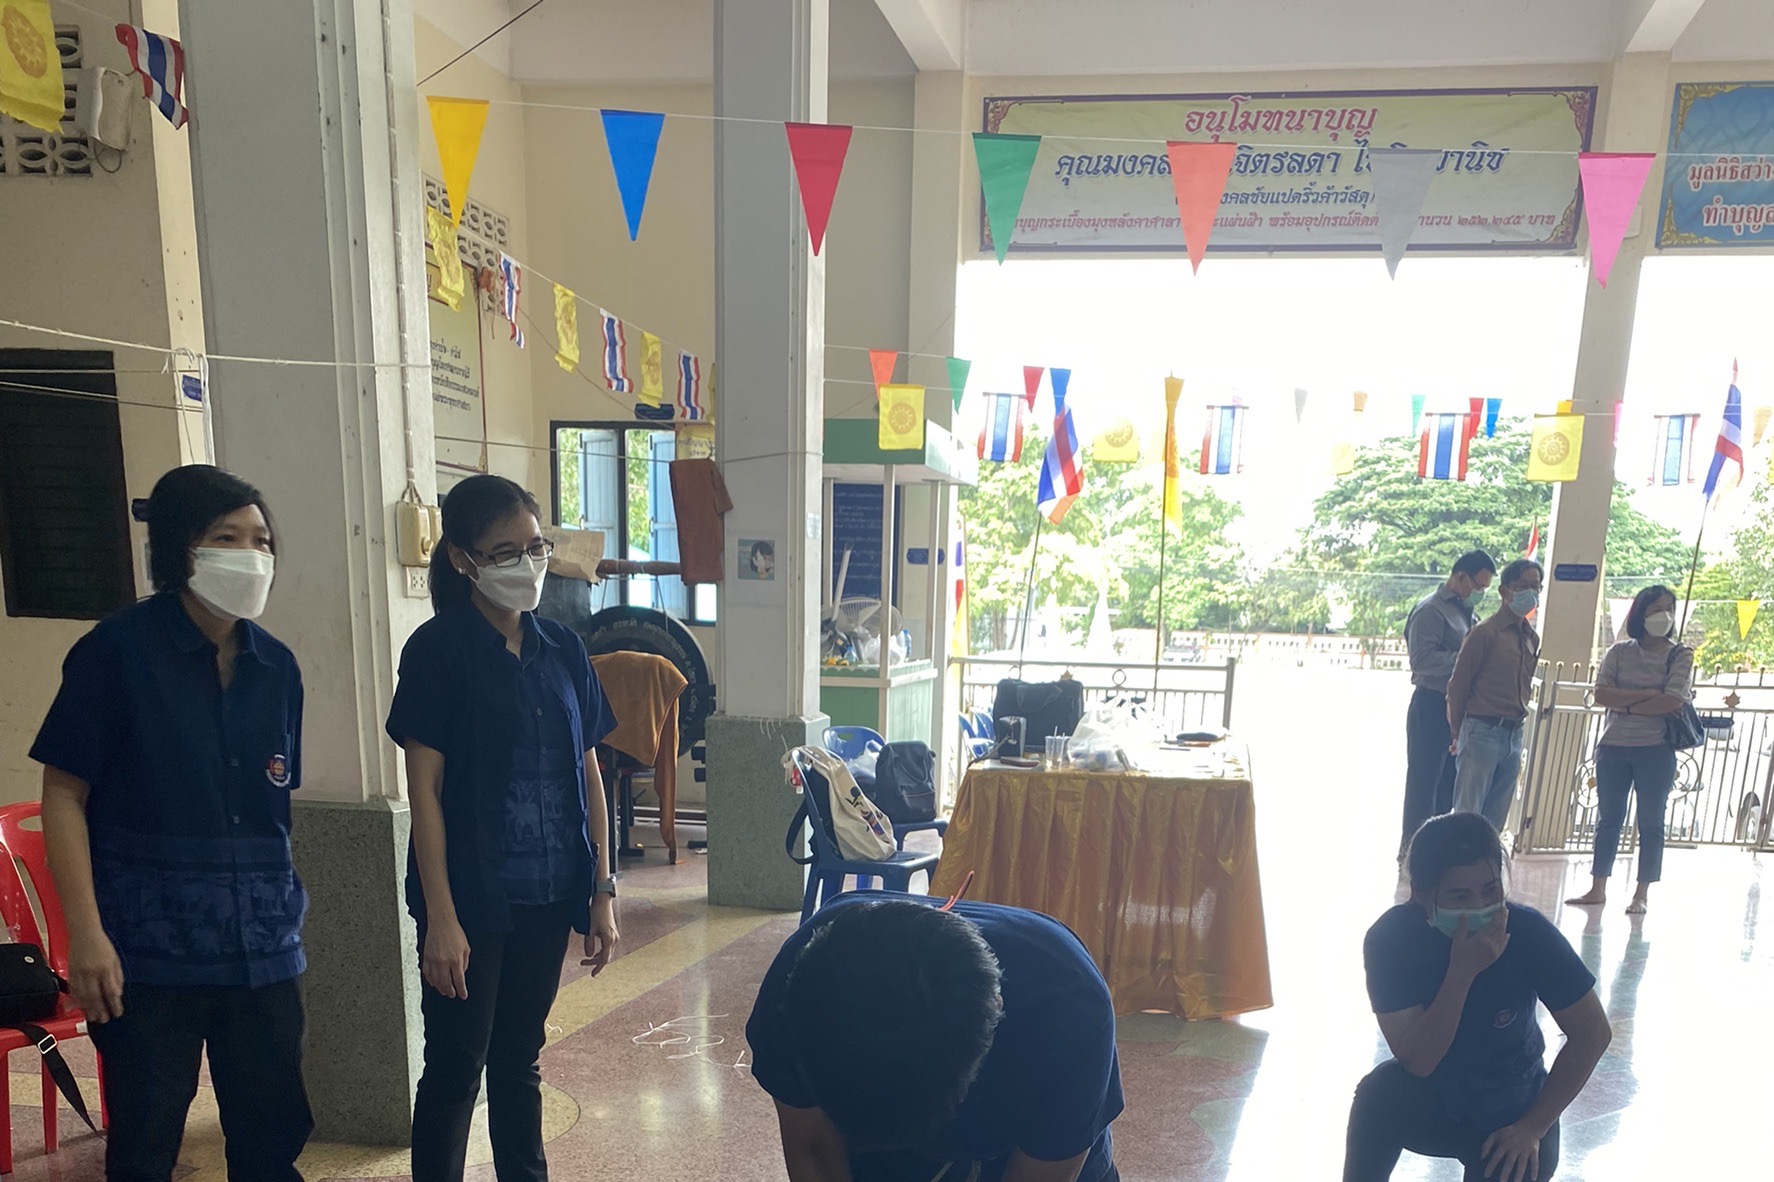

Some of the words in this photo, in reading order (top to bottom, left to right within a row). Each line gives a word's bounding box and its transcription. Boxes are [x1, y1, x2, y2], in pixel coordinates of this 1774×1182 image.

[1185, 95, 1377, 142] อนุโมทนาบุญ
[1527, 213, 1556, 227] บาท
